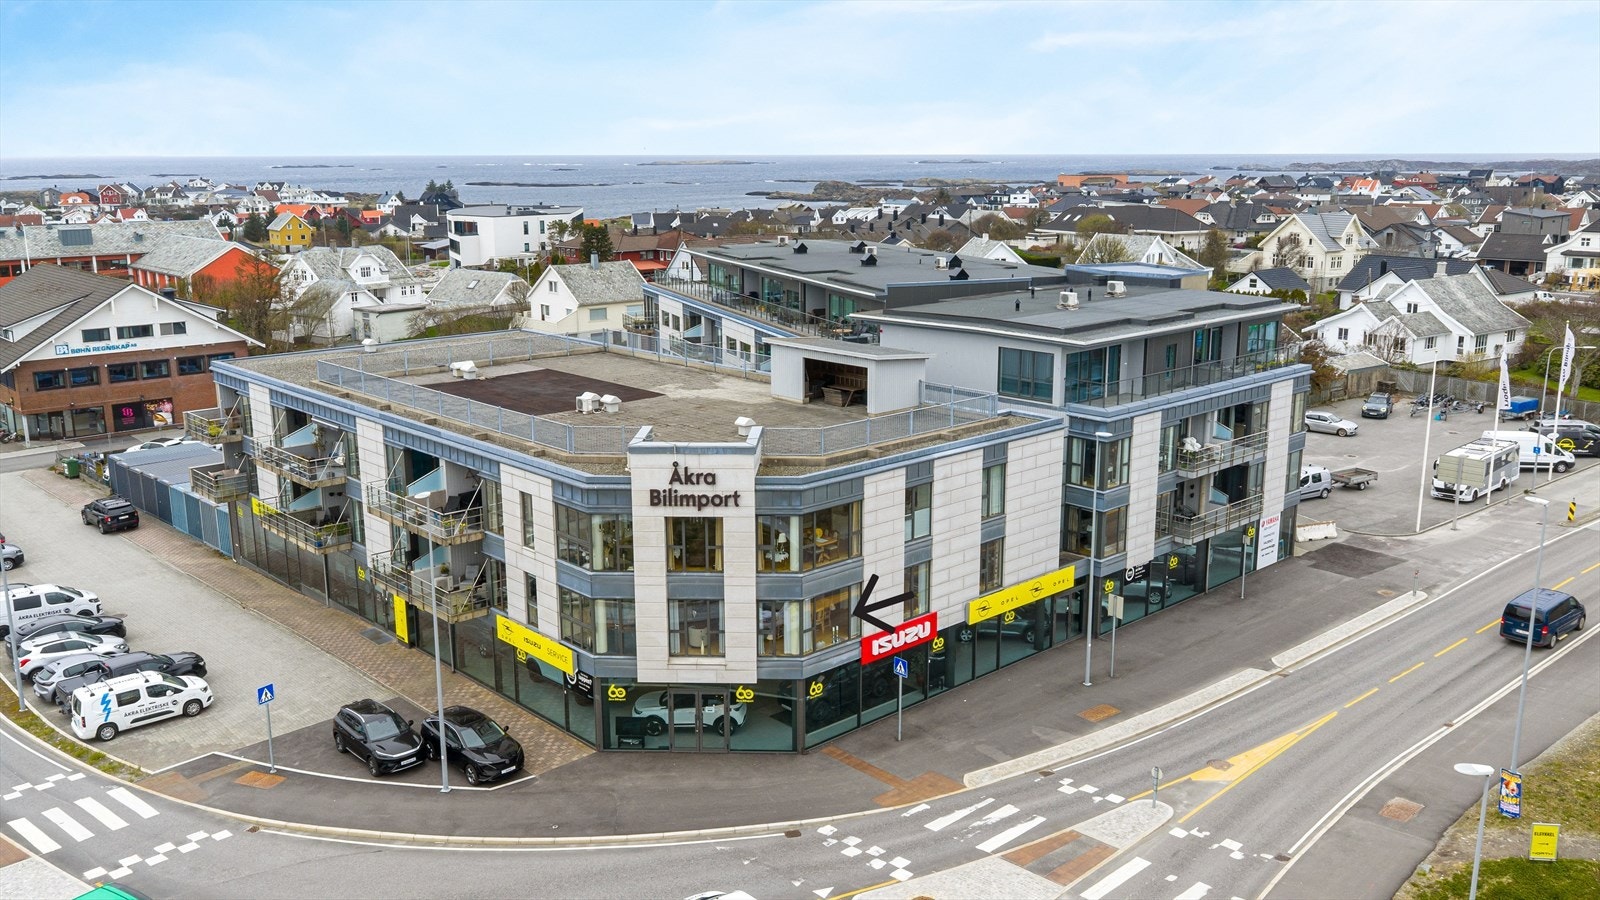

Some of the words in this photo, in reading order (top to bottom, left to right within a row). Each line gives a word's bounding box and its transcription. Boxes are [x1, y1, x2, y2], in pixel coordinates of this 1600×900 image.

[92, 344, 130, 352] REGNSKAP
[669, 461, 716, 485] Åkra
[649, 488, 741, 511] Bilimport
[1053, 578, 1069, 587] OPEL
[1001, 596, 1018, 605] OPEL
[33, 609, 62, 618] ELEKTRISKE
[872, 621, 931, 656] ISUZU
[933, 636, 944, 649] 60
[523, 637, 542, 650] ISUZU
[547, 647, 568, 664] SERVICE
[607, 684, 626, 698] 60
[735, 685, 754, 699] 60
[809, 681, 823, 696] 60
[140, 702, 169, 714] ELEKTRISKE
